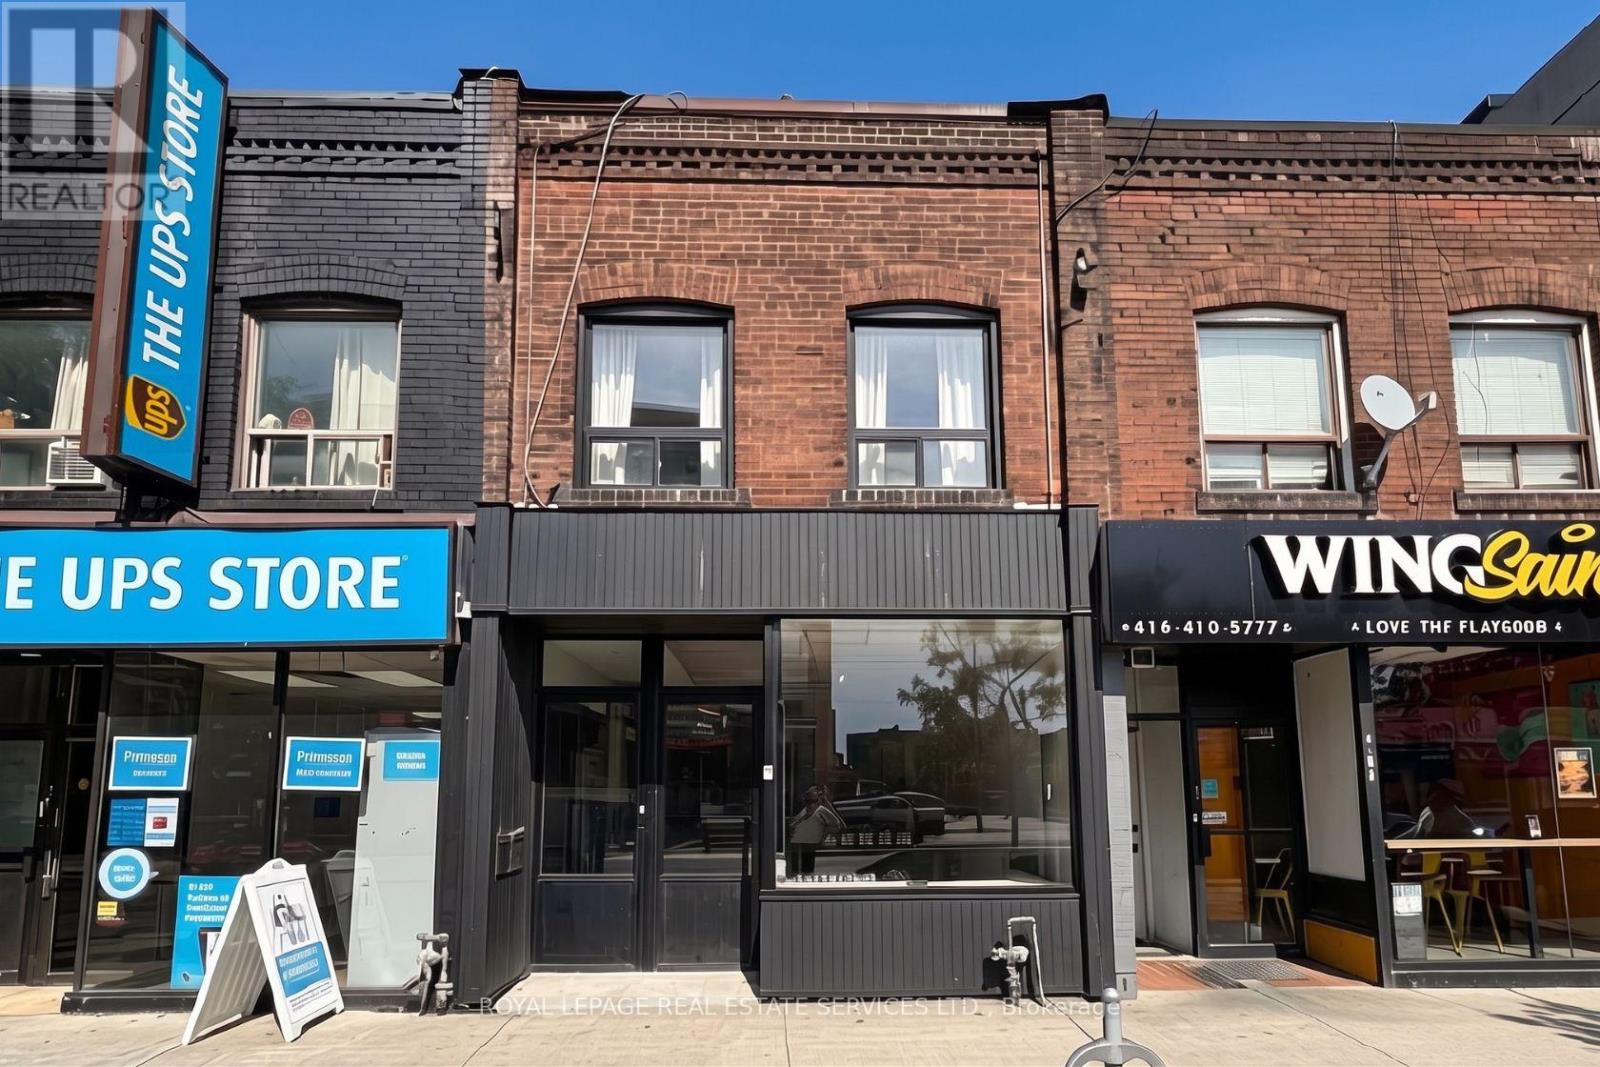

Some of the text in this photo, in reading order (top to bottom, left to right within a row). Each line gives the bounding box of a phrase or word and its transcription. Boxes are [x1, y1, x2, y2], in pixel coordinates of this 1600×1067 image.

[142, 64, 204, 371] THE UPS STORE
[61, 556, 184, 611] UPS
[208, 556, 401, 611] STORE
[1261, 533, 1485, 595] WING
[1366, 620, 1410, 634] LOVE
